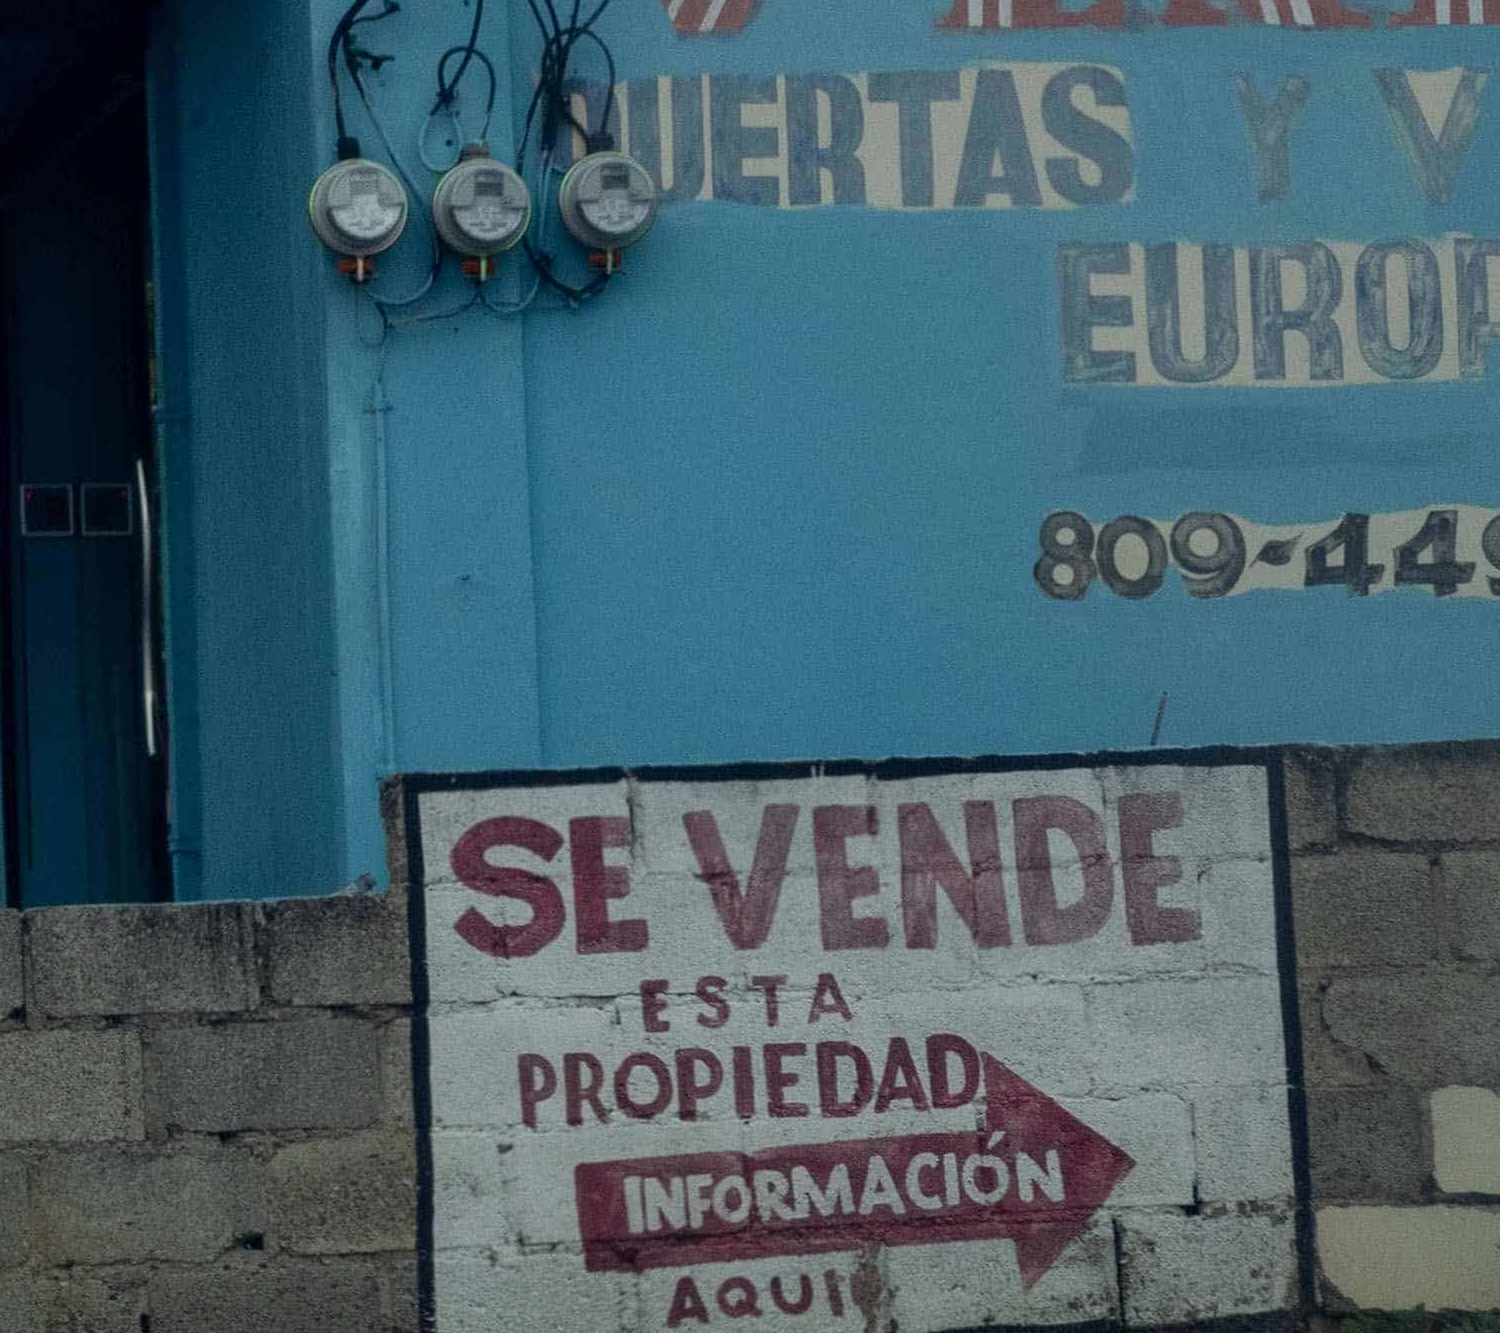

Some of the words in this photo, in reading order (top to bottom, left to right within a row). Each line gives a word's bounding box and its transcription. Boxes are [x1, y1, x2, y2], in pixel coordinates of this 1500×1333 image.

[1032, 507, 1500, 601] 809-44
[449, 813, 649, 959] SE
[681, 791, 1204, 954] VENDE
[640, 971, 855, 1034] ESTA
[516, 1032, 983, 1130] PROPIEDAD
[621, 1130, 1067, 1235] INFORMACIÓN
[665, 1268, 846, 1330] AQUI
